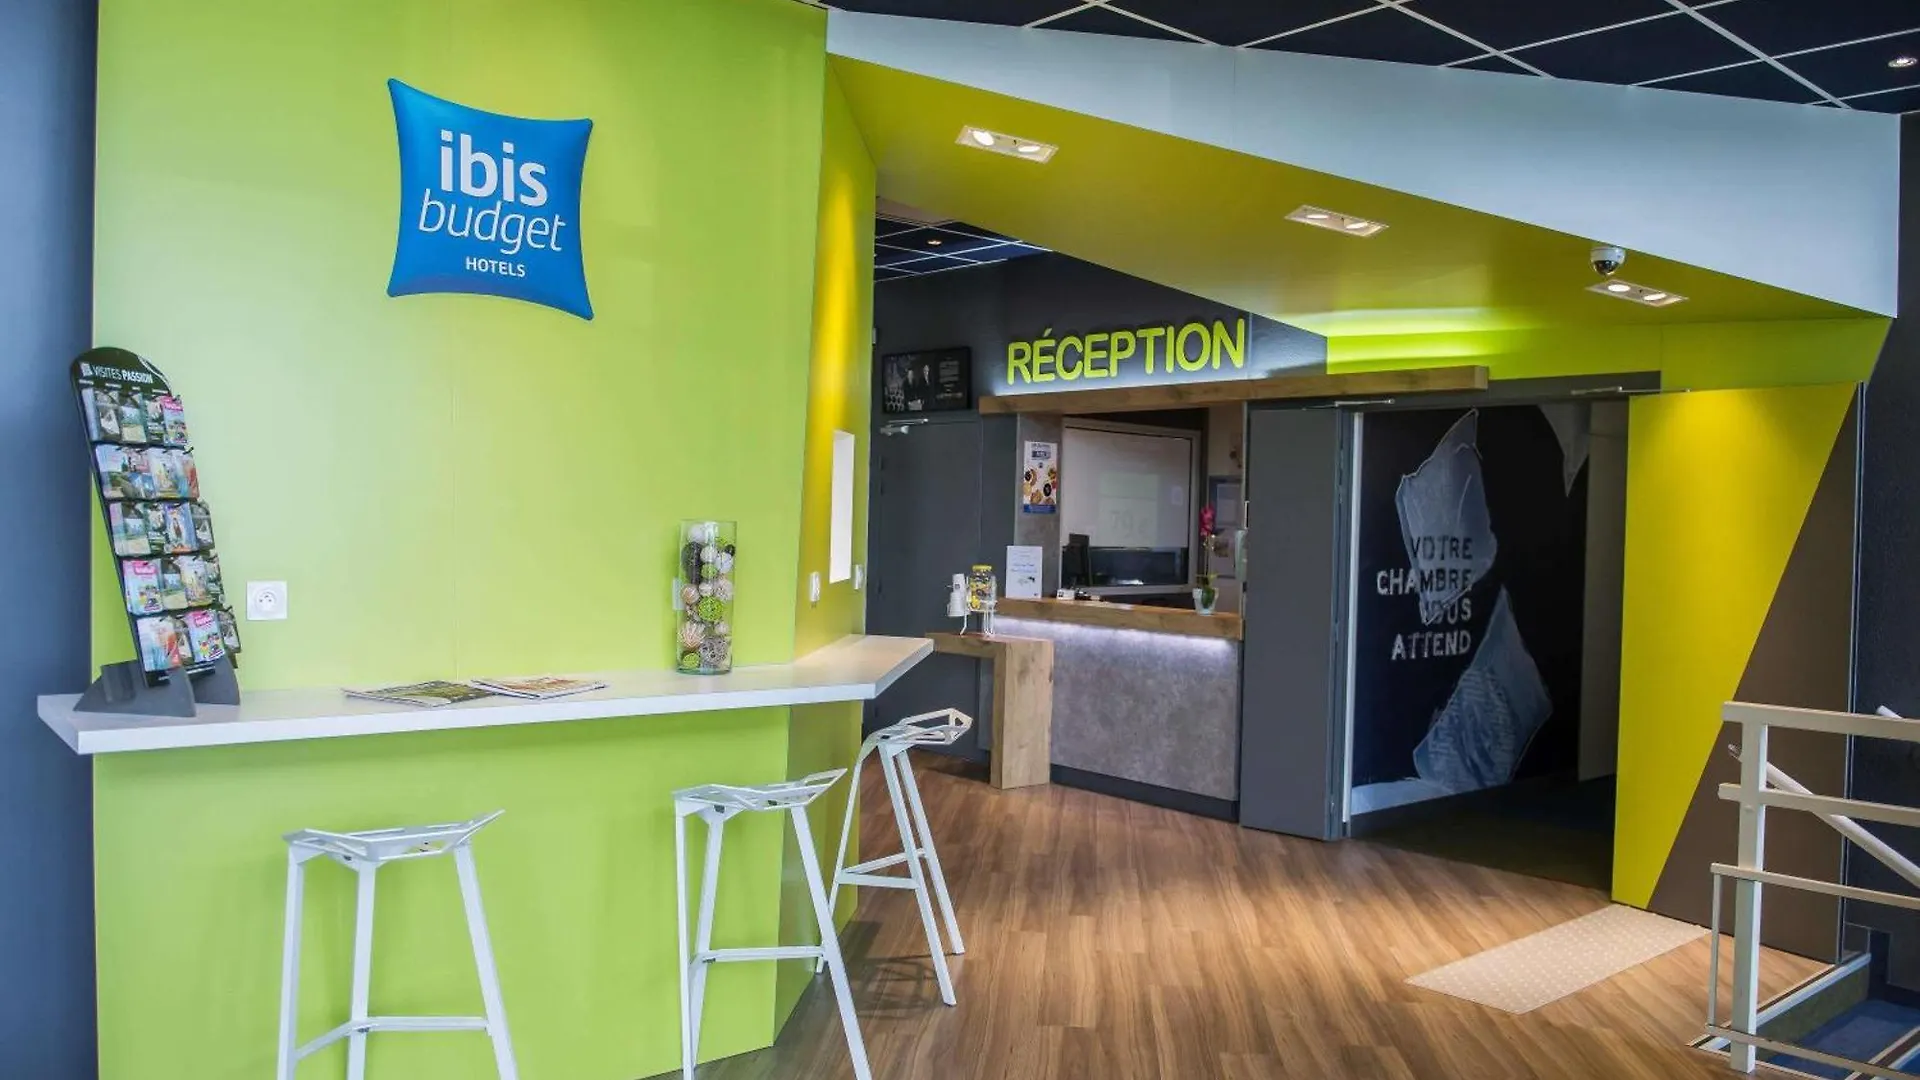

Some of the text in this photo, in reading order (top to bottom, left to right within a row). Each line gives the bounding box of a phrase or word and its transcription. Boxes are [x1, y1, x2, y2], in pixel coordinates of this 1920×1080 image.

[440, 129, 548, 207] ibis
[418, 188, 567, 255] budget
[465, 256, 526, 278] HOTELS
[1006, 318, 1245, 385] RÉCEPTION
[92, 365, 154, 384] VISITES PASSION
[1411, 535, 1474, 561] VOTRE
[1376, 568, 1474, 596] CHAMBRE
[1391, 630, 1472, 660] ATTEND
